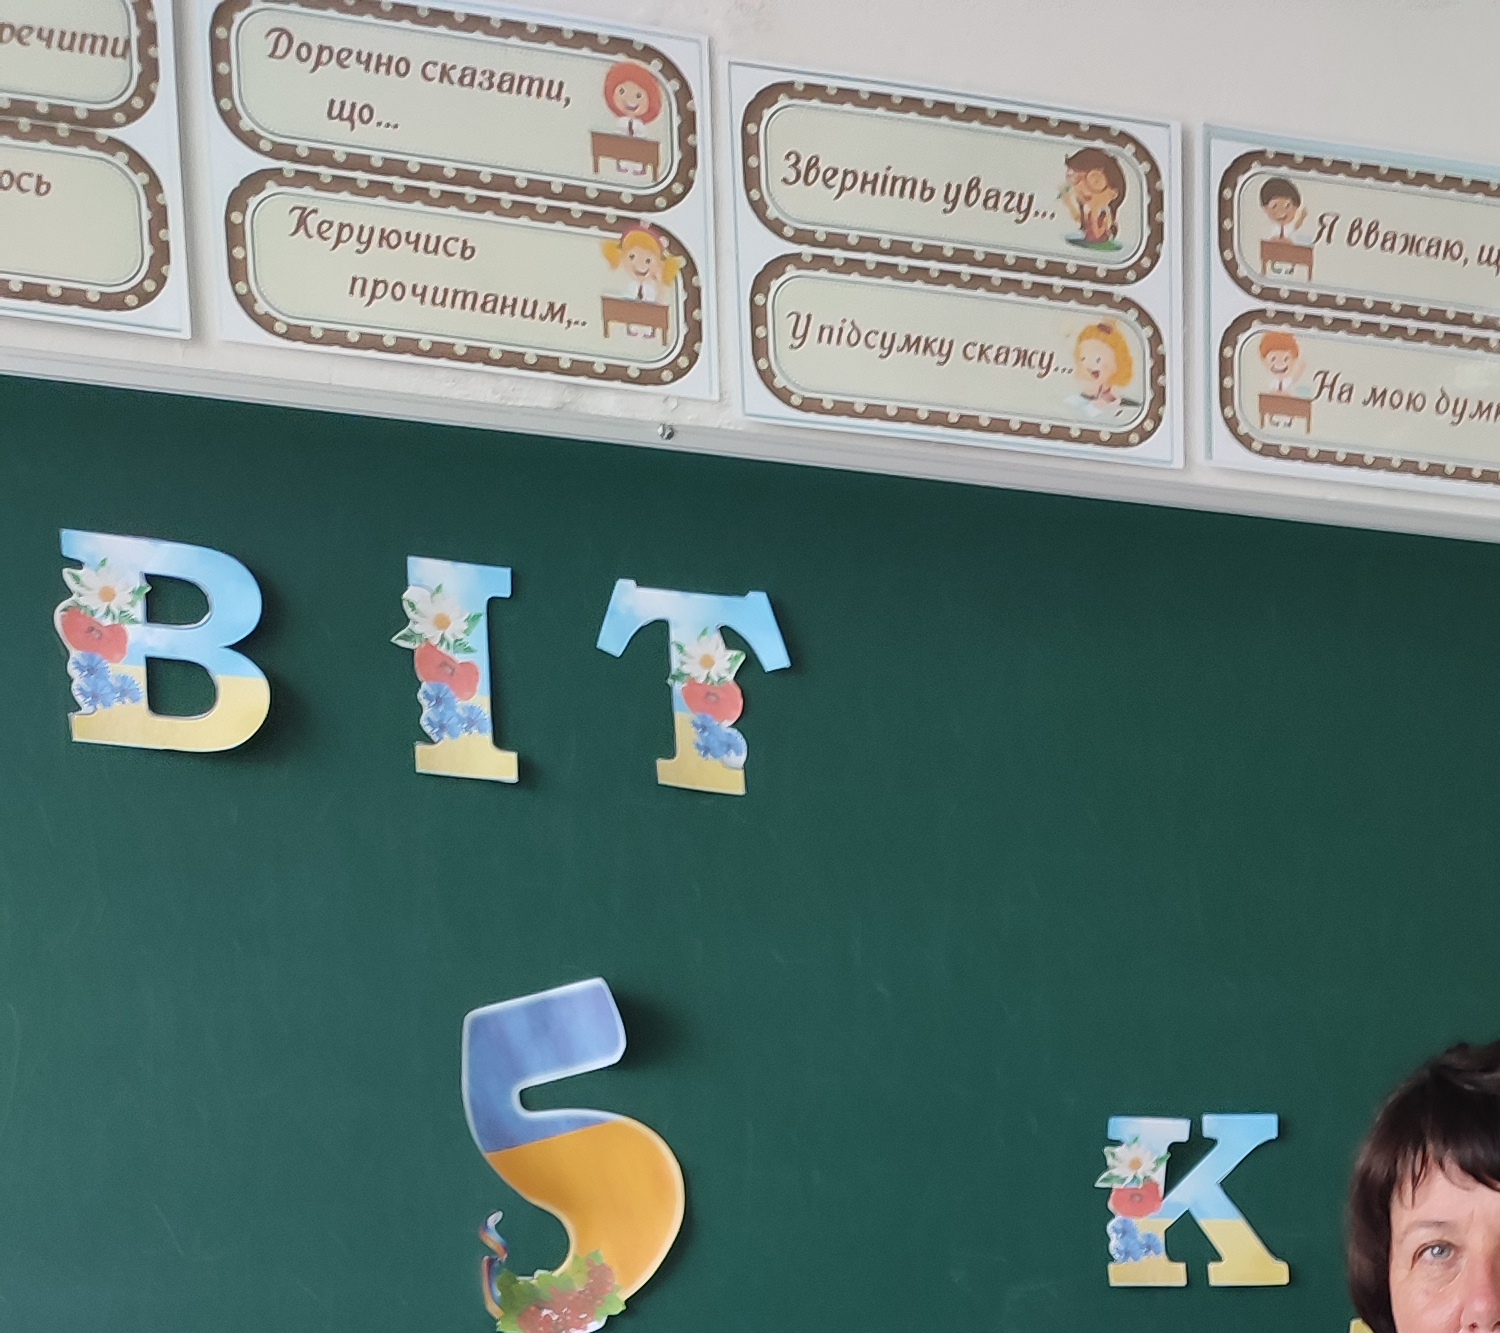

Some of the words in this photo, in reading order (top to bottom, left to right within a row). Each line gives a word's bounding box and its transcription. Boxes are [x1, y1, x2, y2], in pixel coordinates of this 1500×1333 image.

[264, 26, 411, 83] Доречно
[420, 55, 573, 109] сказати,
[326, 96, 400, 132] що...
[780, 150, 936, 202] Зверніть
[942, 175, 1056, 224] увагу...
[287, 205, 477, 262] Керуючись
[1311, 212, 1340, 245] Я
[1346, 218, 1470, 268] вважаю,
[786, 311, 814, 350] У
[816, 317, 955, 367] підсумку
[961, 342, 1074, 378] скажу...
[1312, 370, 1354, 404] На
[1362, 388, 1428, 414] мою
